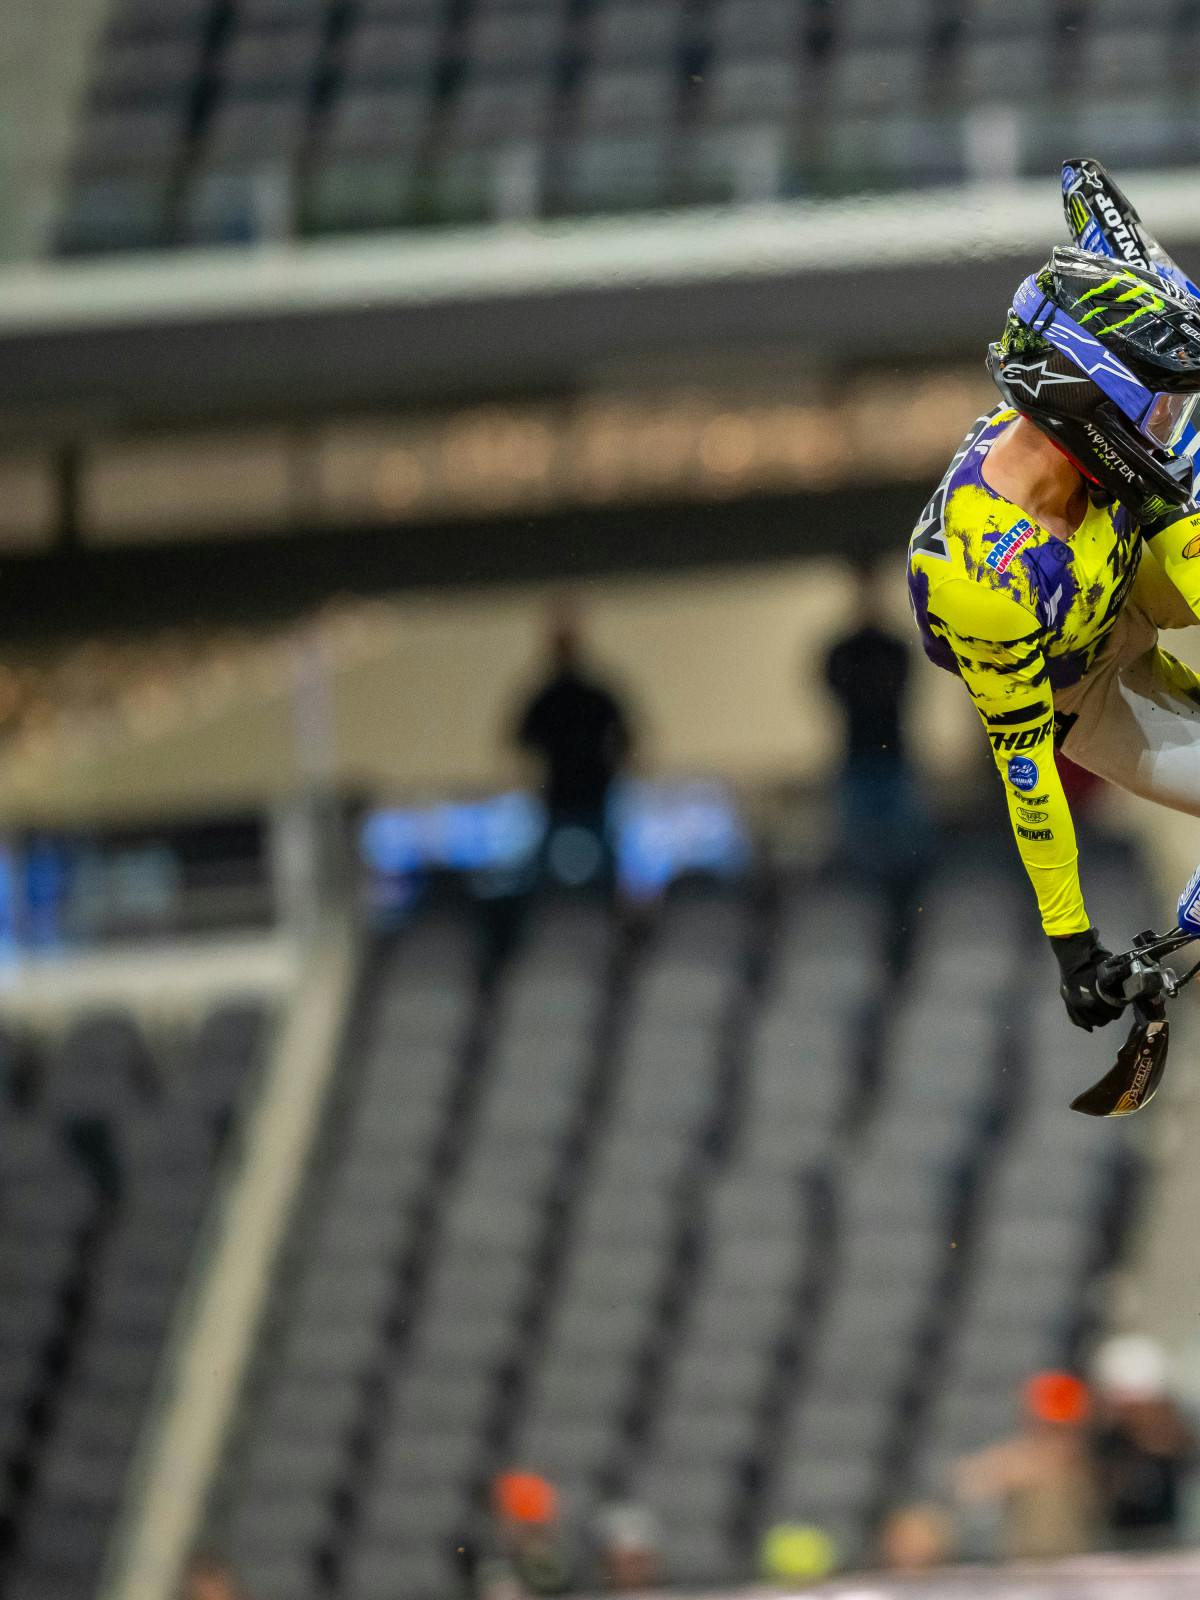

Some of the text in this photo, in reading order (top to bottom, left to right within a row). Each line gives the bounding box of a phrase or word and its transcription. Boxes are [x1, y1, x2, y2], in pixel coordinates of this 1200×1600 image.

[1095, 192, 1150, 270] UNLOP
[1084, 424, 1136, 484] MONSTER
[1093, 448, 1116, 471] ARMY
[986, 518, 1031, 568] PARTS
[996, 527, 1034, 574] UNLIMITED
